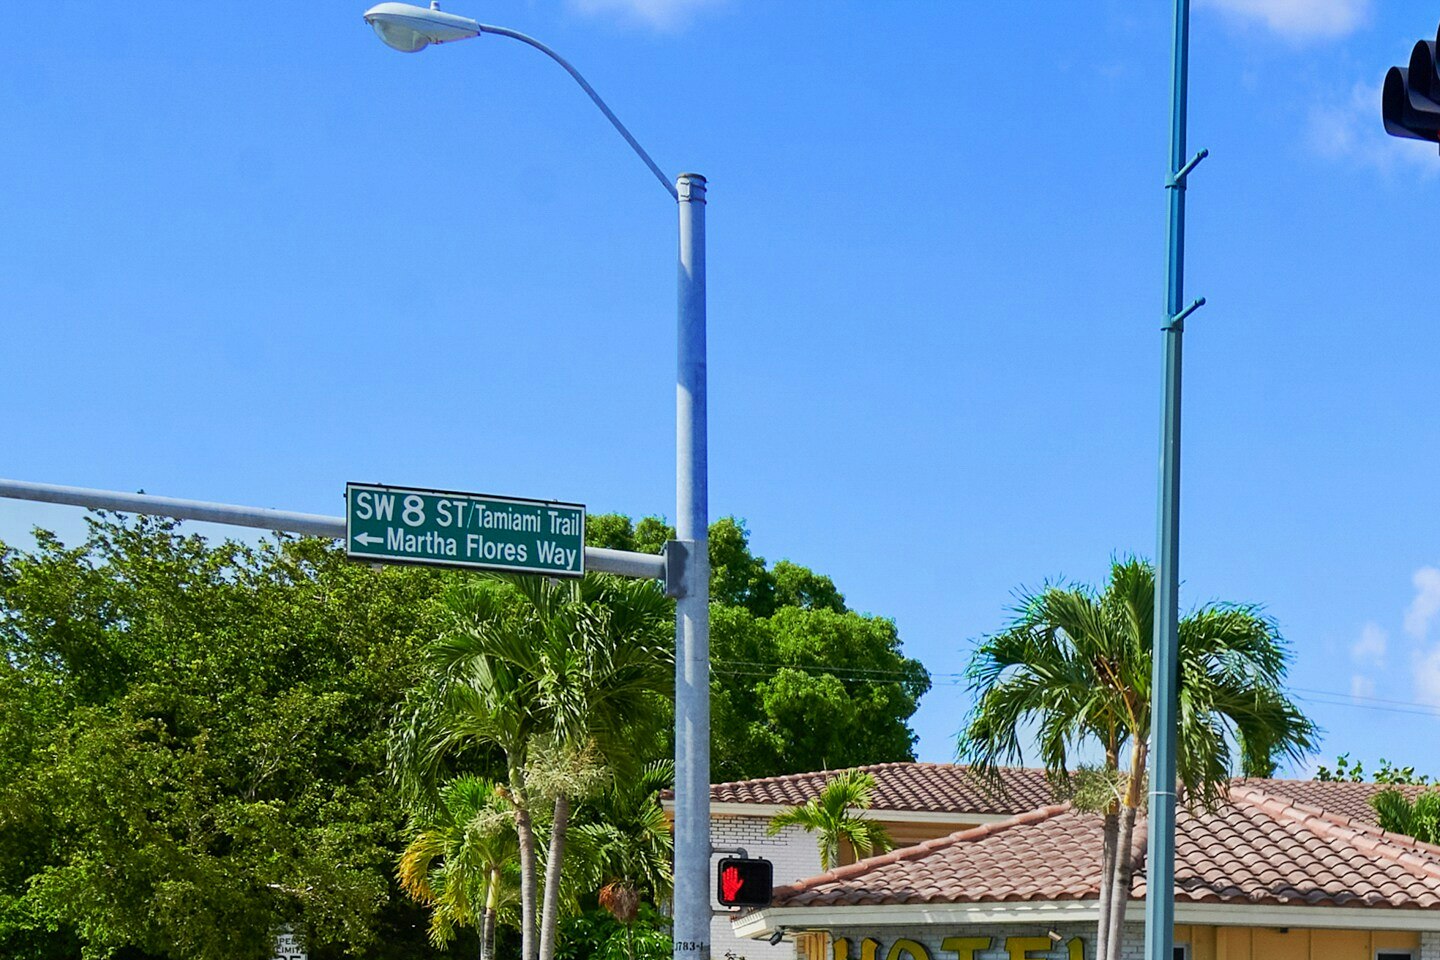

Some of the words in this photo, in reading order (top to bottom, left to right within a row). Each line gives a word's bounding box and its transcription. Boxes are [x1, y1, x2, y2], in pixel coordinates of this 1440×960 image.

[356, 492, 395, 522] SW
[401, 494, 426, 527] 8
[547, 510, 580, 536] Trail
[386, 526, 457, 556] Martha
[466, 533, 528, 562] Flores
[536, 540, 577, 570] Way
